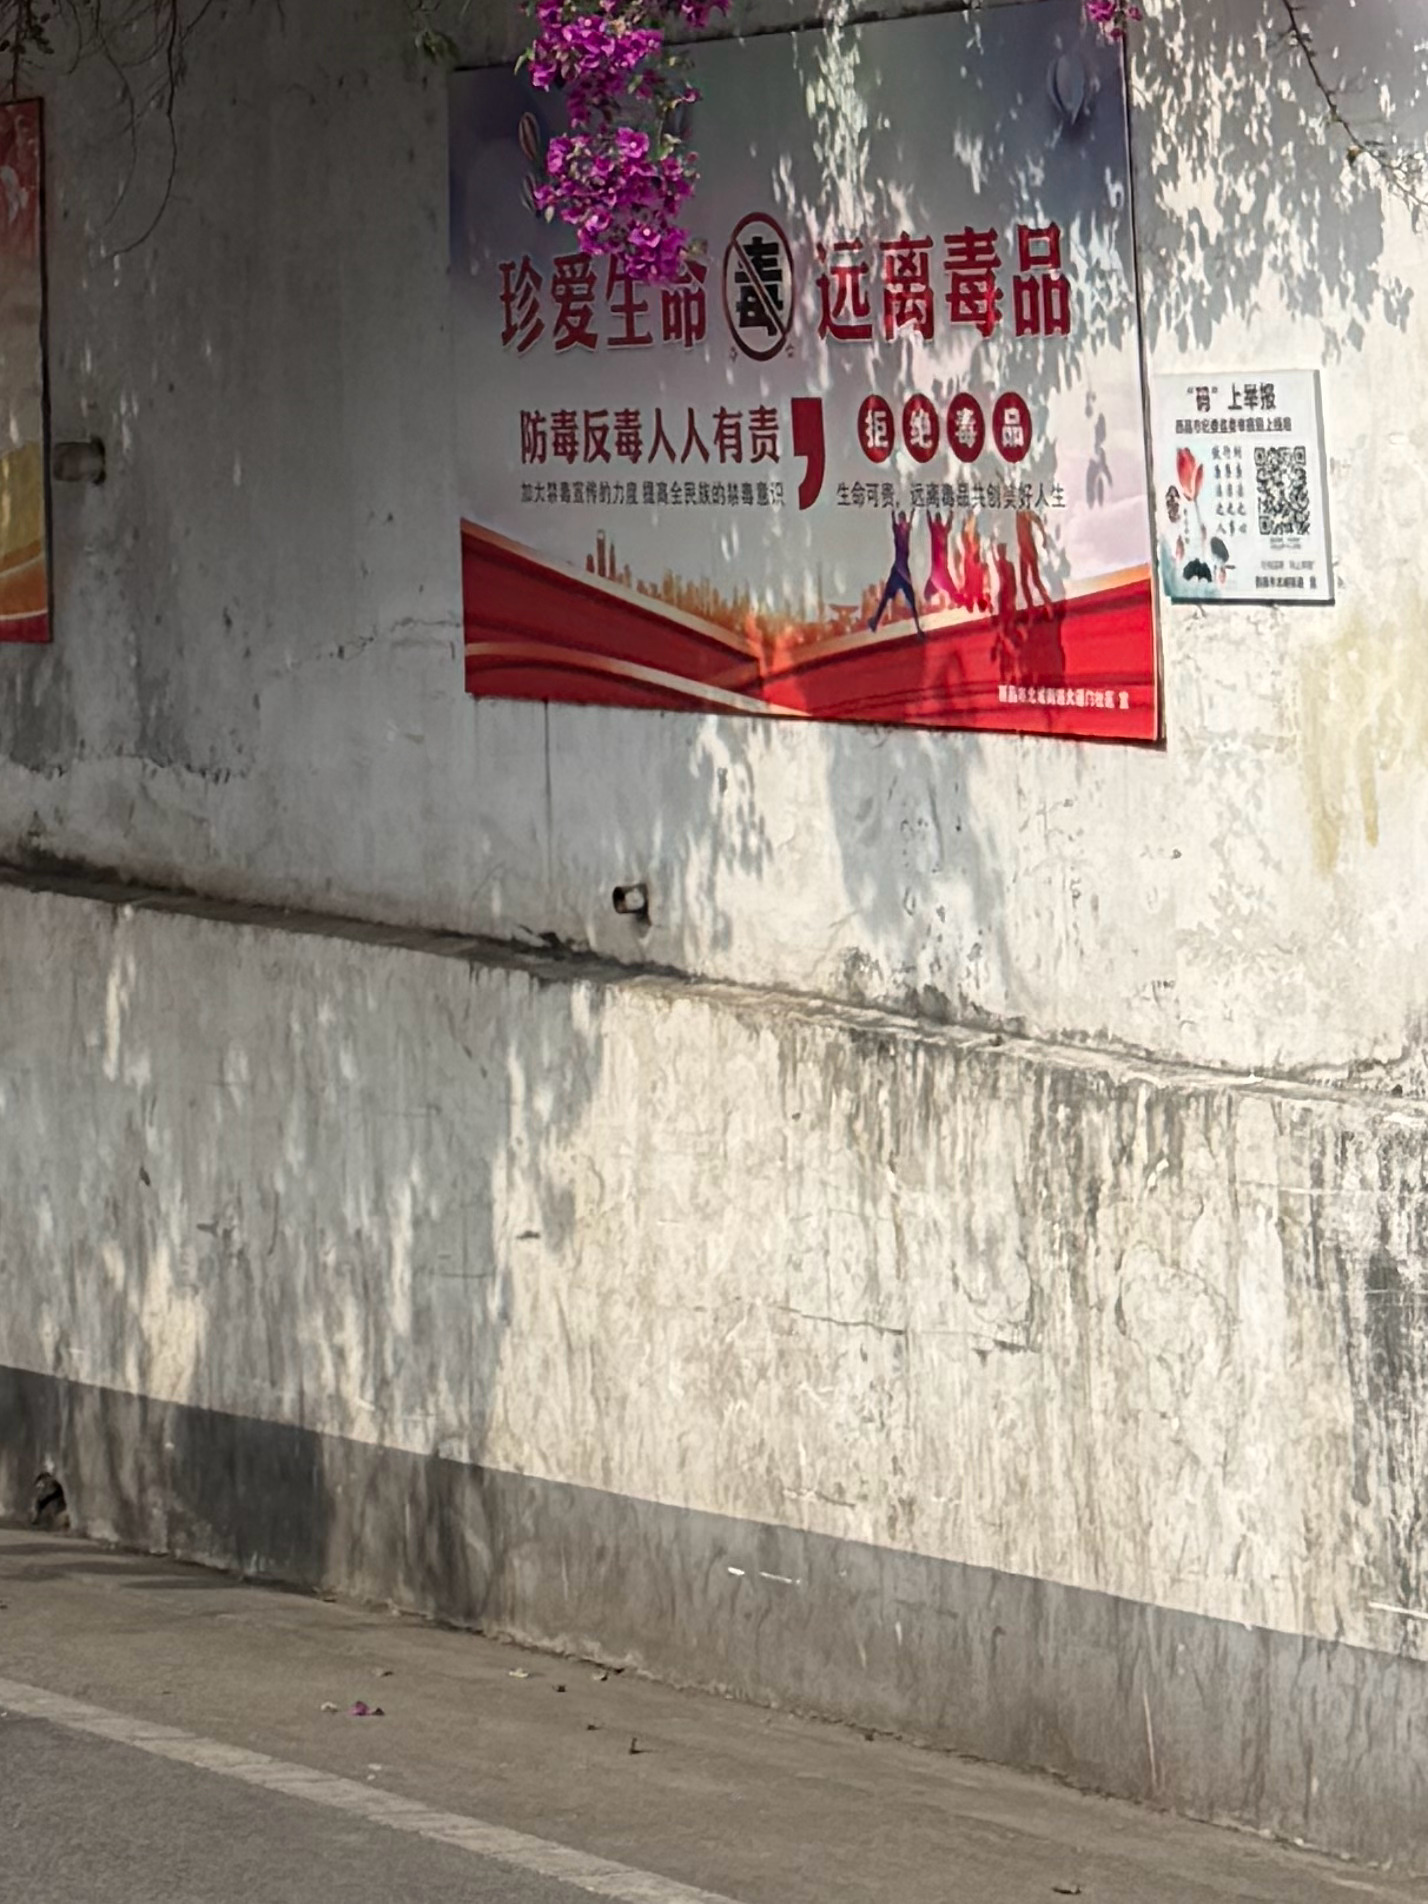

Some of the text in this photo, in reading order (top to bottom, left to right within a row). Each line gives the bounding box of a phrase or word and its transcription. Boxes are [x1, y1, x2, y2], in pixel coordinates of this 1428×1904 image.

[498, 222, 1071, 354] 珍爱生命 毒 远离毒品
